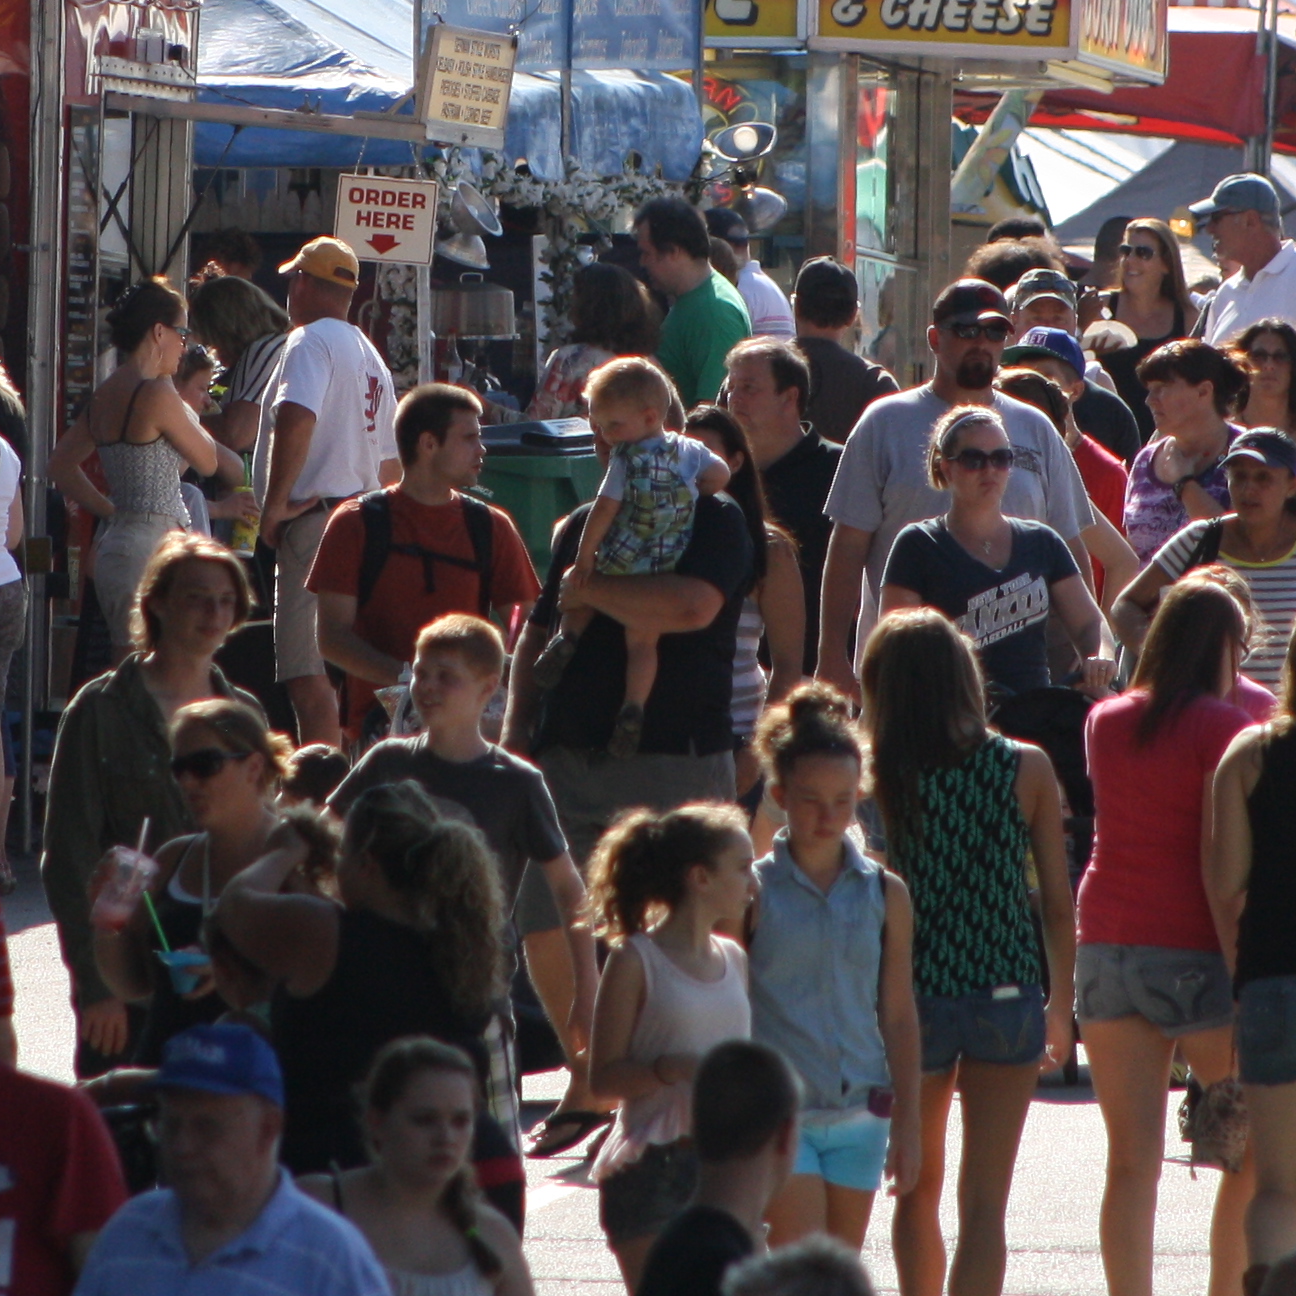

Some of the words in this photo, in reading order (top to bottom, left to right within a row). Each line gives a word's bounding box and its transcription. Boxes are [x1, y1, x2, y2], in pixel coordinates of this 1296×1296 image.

[348, 186, 427, 210] ORDER
[355, 209, 416, 232] HERE
[967, 586, 999, 612] NEW
[999, 571, 1033, 597] YORK
